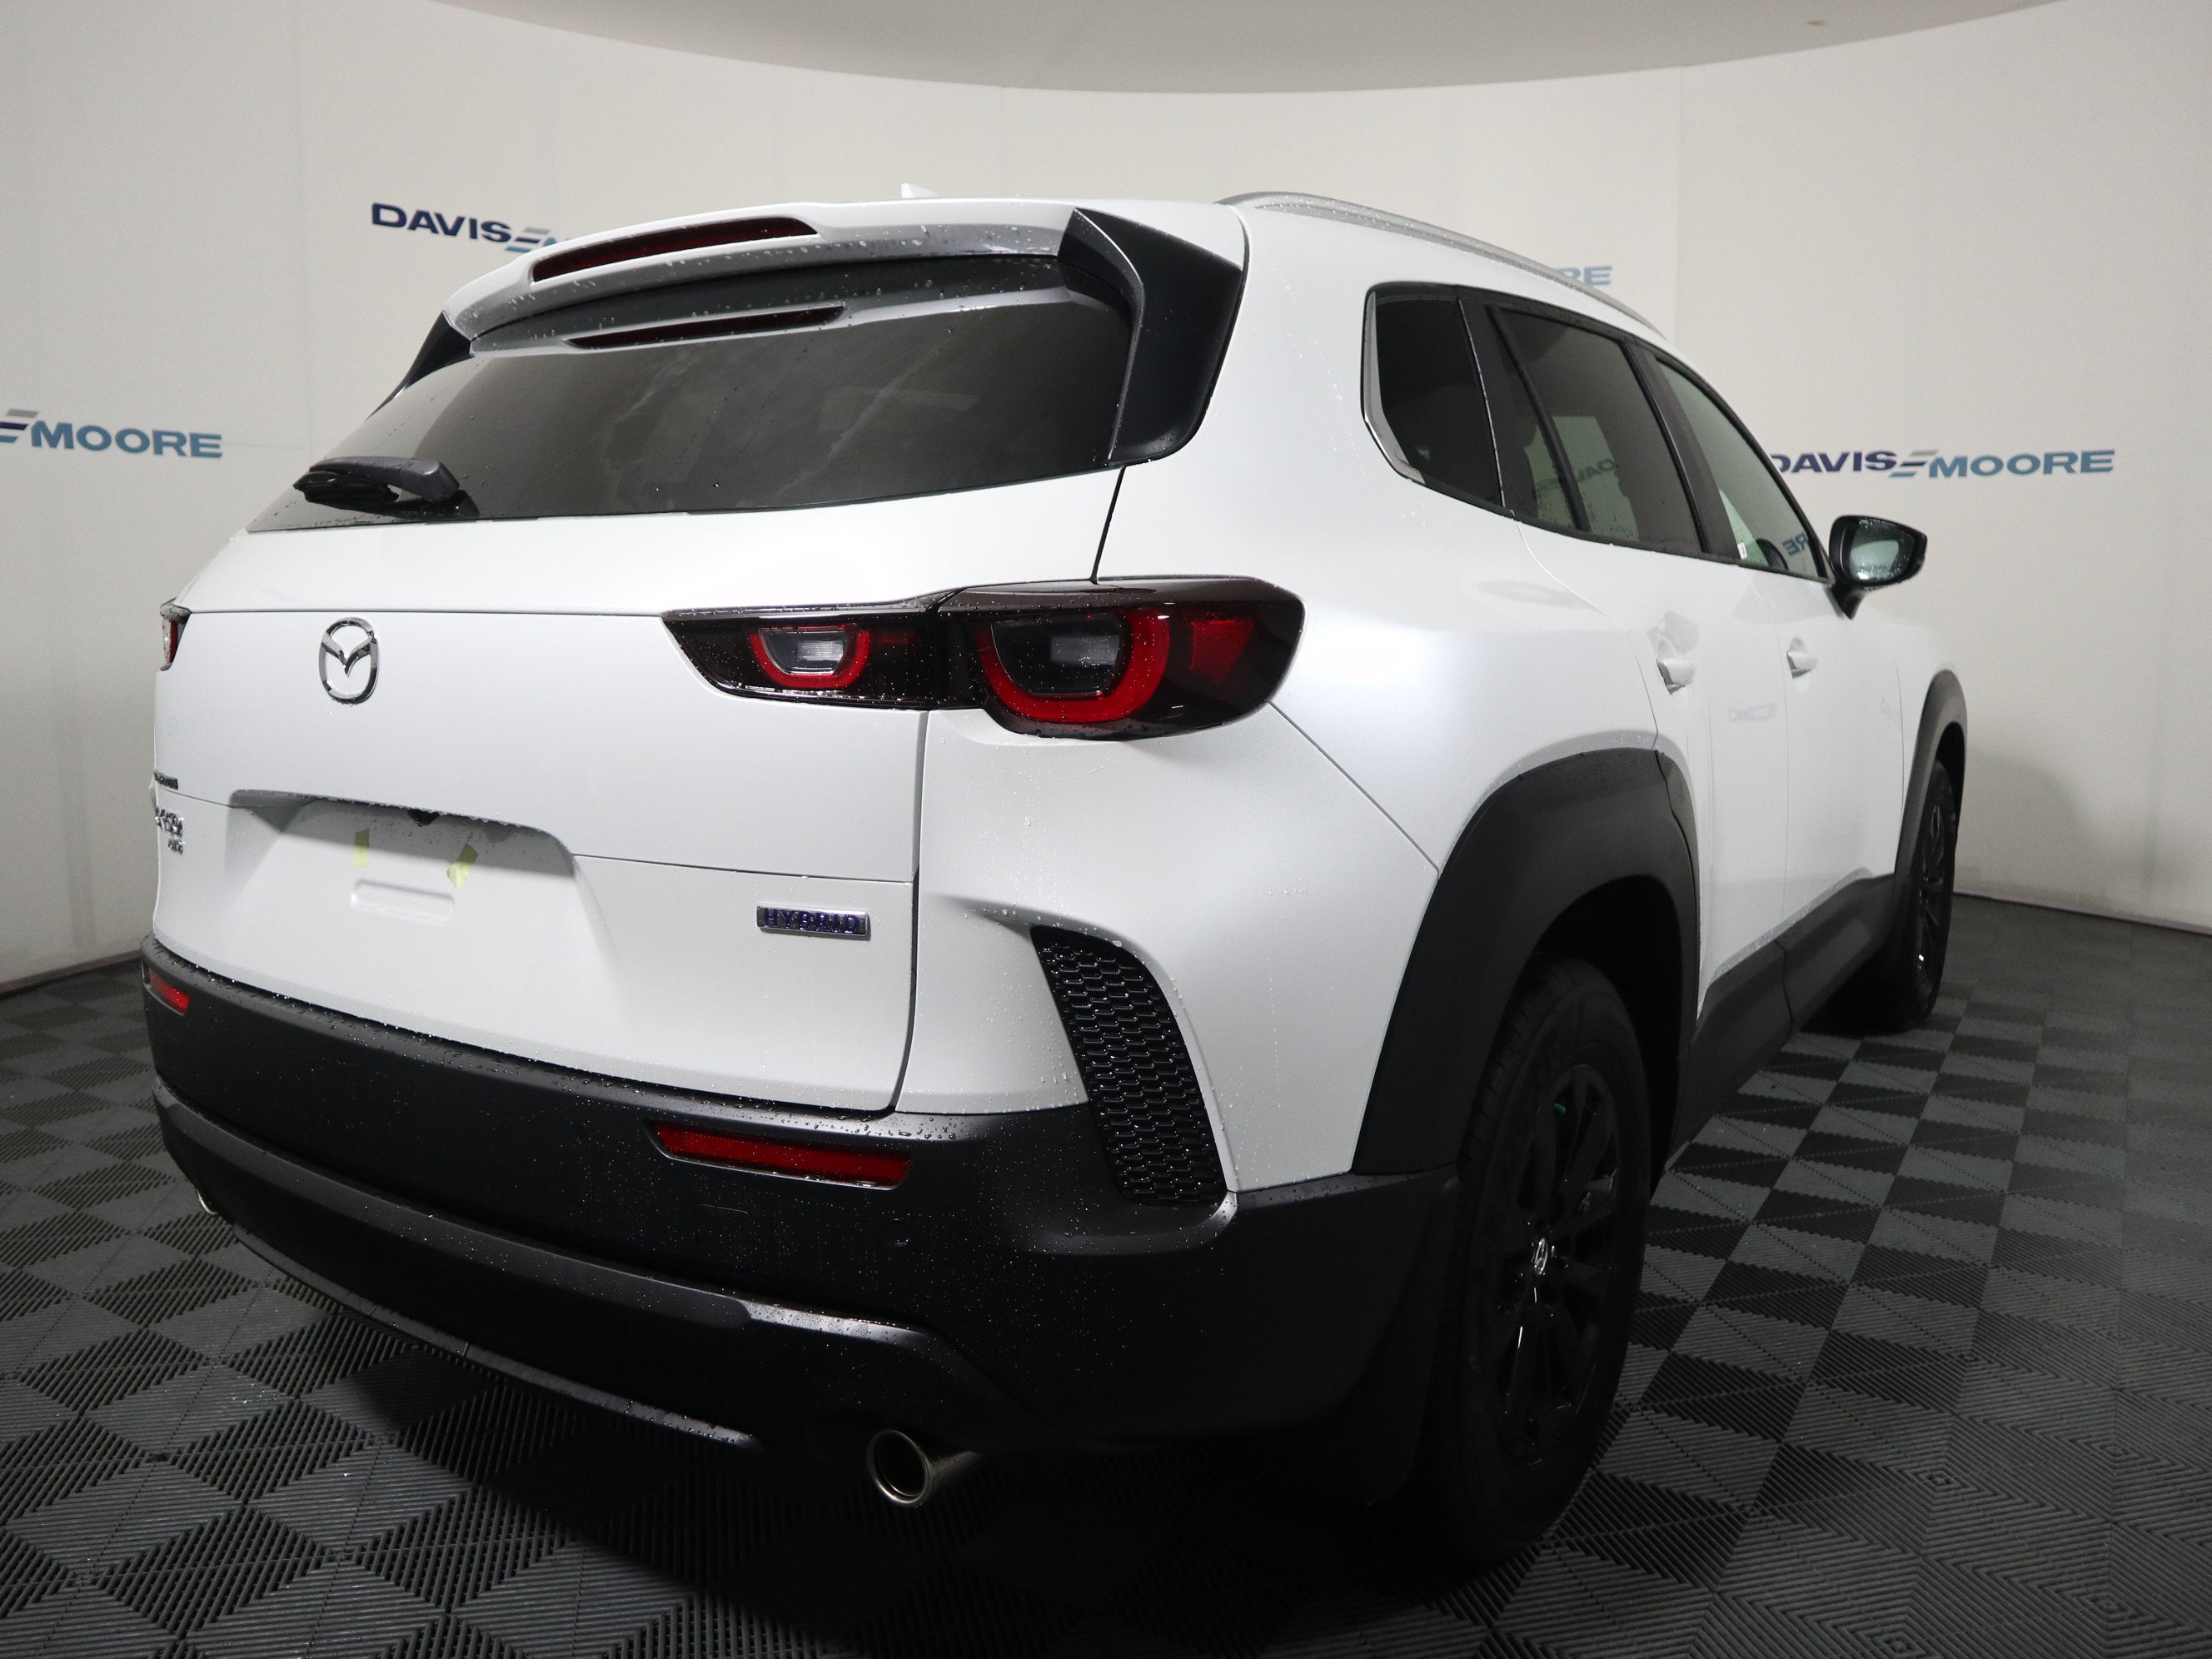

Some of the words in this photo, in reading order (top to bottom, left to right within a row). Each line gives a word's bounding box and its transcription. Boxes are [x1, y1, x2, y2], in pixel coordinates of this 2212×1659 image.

[371, 202, 511, 243] DAVIS
[31, 420, 223, 458] MOORE
[1769, 450, 1897, 473] DAVIS
[1929, 449, 2115, 478] MOORE
[764, 908, 861, 934] HYBRID
